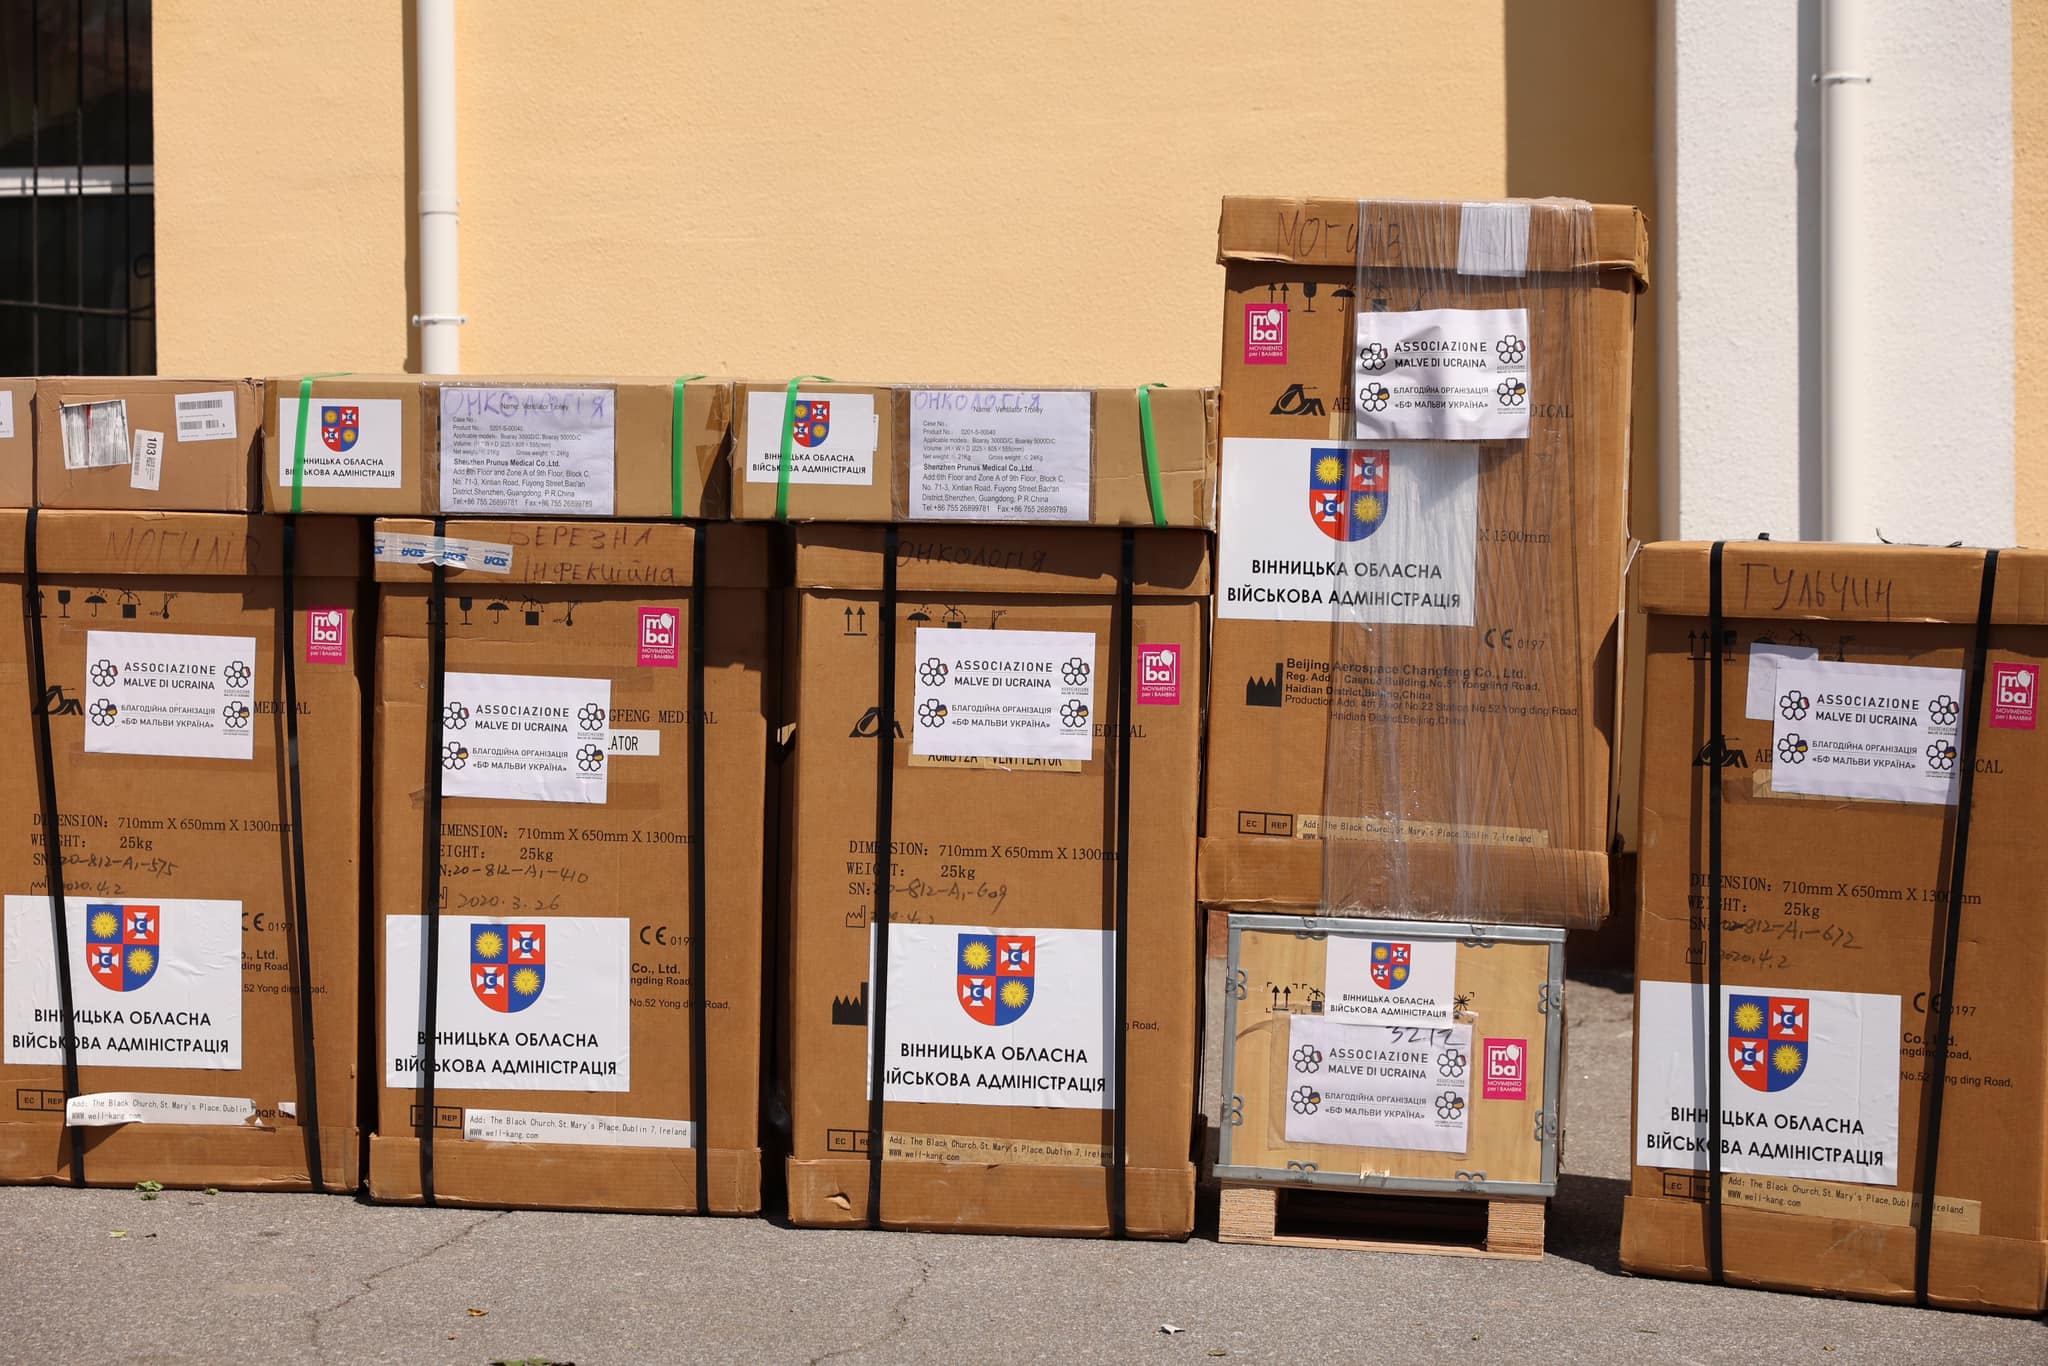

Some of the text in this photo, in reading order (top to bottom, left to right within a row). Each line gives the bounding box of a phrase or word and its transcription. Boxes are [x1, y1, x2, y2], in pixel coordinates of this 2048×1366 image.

[1394, 339, 1486, 352] ASSOCIAZIONE
[1394, 357, 1486, 369] MALVE DI UCRAINA
[1414, 399, 1445, 409] МАЛЬВИ
[333, 469, 394, 477] АДМІНІСТРАЦІЯ
[802, 465, 866, 474] АДМІНІСТРАЦІЯ
[1252, 559, 1442, 580] ВІННИЦЬКА ОБЛАСНА
[1228, 585, 1459, 609] ВІЙСЬКОВА АДМІНІСТРАЦІЯ
[124, 662, 216, 675] ASSOCIAZIONE
[955, 660, 1053, 673] ASSOCIAZIONE
[1287, 657, 1329, 673] Beijing
[124, 678, 215, 690] MALVE DI UCRAINA
[954, 676, 1051, 687] MALVE DI UCRAINA
[1285, 684, 1322, 695] Haidian
[121, 703, 215, 715] БЛАГОДІЙНА ОРГАНІЗАЦІЯ
[952, 702, 1051, 714] БЛАГОДІЙНА ОРГАНІЗАЦІЯ
[1817, 694, 1919, 710] ASSOCIAZIONE
[476, 704, 569, 718] ASSOCIAZIONE
[658, 709, 718, 725] MEDIAL
[140, 717, 174, 728] МАЛЬВИ
[475, 720, 567, 733] MALVE DI UCRAINA
[971, 718, 1007, 728] МАЛЬВИ
[1816, 712, 1917, 727] MALVE DI UCRAINA
[472, 747, 568, 759] БЛАГОДІЙНА ОРГАНІЗАЦІЯ
[1812, 740, 1917, 755] БЛАГОДІЙНА ОРГАНІЗАЦІЯ
[492, 761, 526, 771] МАЛЬВИ
[1834, 757, 1871, 768] МАЛЬВИ
[118, 816, 164, 830] 710mm
[180, 818, 225, 831] 650mm
[440, 824, 508, 839] IMENSION:
[518, 827, 565, 840] 710mm
[581, 829, 628, 842] 650mm
[120, 836, 153, 850] 25kg
[440, 845, 553, 862] EIGHT: 25kg
[939, 844, 1053, 859] 710mm 650mm
[941, 865, 976, 880] 25kg
[1783, 880, 1902, 901] 710mm 650mm
[1784, 902, 1820, 918] 25kg
[1343, 994, 1435, 1006] ВІННИЦЬКА ОБЛАСНА
[1330, 1004, 1447, 1017] ВІЙСЬКОВА АДМІНІСТРАЦІЯ
[130, 1011, 210, 1026] ОБЛАСНА
[107, 1039, 228, 1054] АДМІНІСТРАЦІЯ
[516, 1032, 598, 1048] ОБЛАСНА
[901, 1044, 1087, 1063] ВІННИЦЬКА ОБЛАСНА
[1329, 1048, 1428, 1063] ASSOCIAZIONE
[492, 1059, 616, 1076] АДМІНІСТРАЦІЯ
[1328, 1065, 1426, 1079] MALVE DI UCRAINA
[886, 1069, 1106, 1092] ІЙСЬКОВА АДМІНІСТРАЦІЯ
[1325, 1092, 1426, 1105] БЛАГОДІЙНА ОРГАНІЗАЦІЯ
[1345, 1107, 1382, 1117] МАЛЬВИ
[491, 1116, 503, 1124] The
[506, 1117, 526, 1126] Black
[1672, 1106, 1864, 1135] ВІННЦЬКА ОБЛАСНА
[910, 1137, 922, 1146] The
[926, 1138, 948, 1148] Black
[1749, 1142, 1883, 1166] АДМІНІСТРАЦІЯ
[1750, 1178, 1764, 1189] The
[1766, 1181, 1787, 1192] Black
